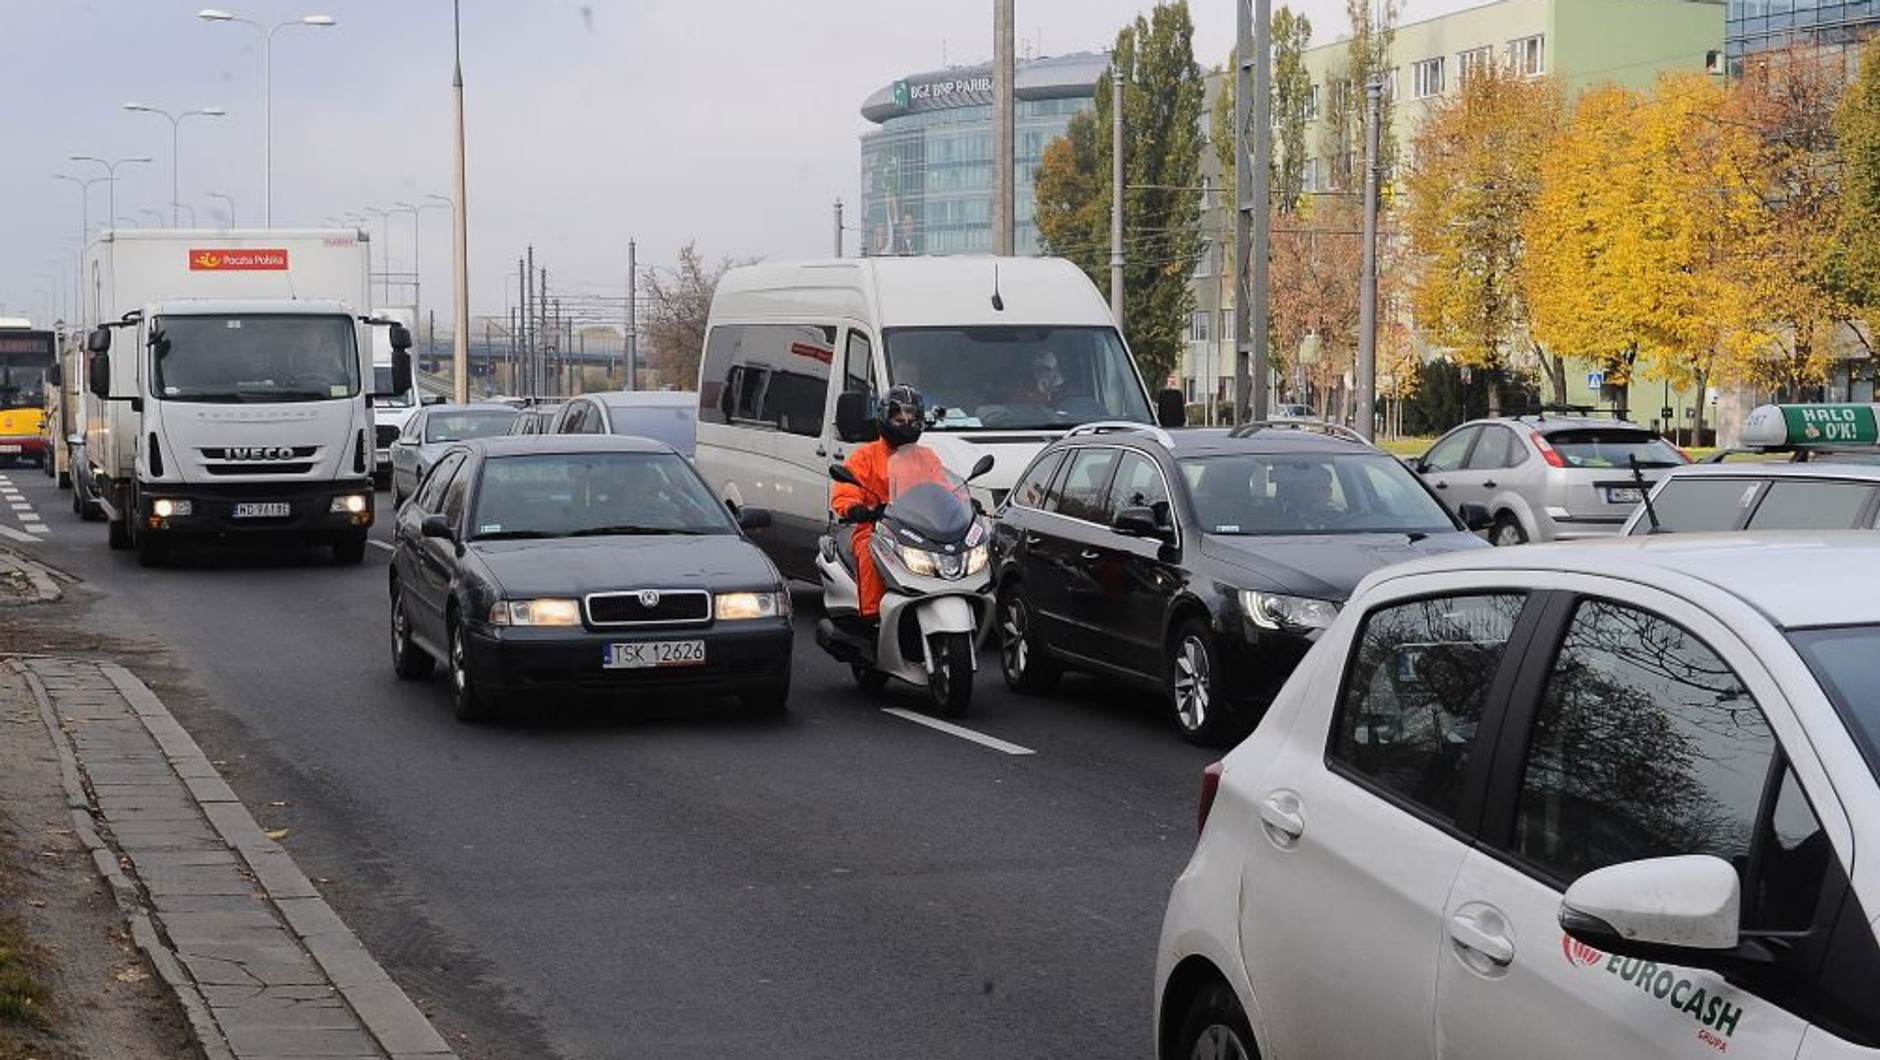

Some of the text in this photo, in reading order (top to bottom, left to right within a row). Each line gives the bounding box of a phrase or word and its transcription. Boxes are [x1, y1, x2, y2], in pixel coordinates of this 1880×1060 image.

[933, 82, 955, 98] BNP
[223, 254, 284, 265] Poczta Polska
[224, 447, 294, 461] IVECO
[613, 642, 704, 663] TSK 12626
[1606, 953, 1743, 1038] EUROCASH
[1698, 1028, 1728, 1054] GRUPA
